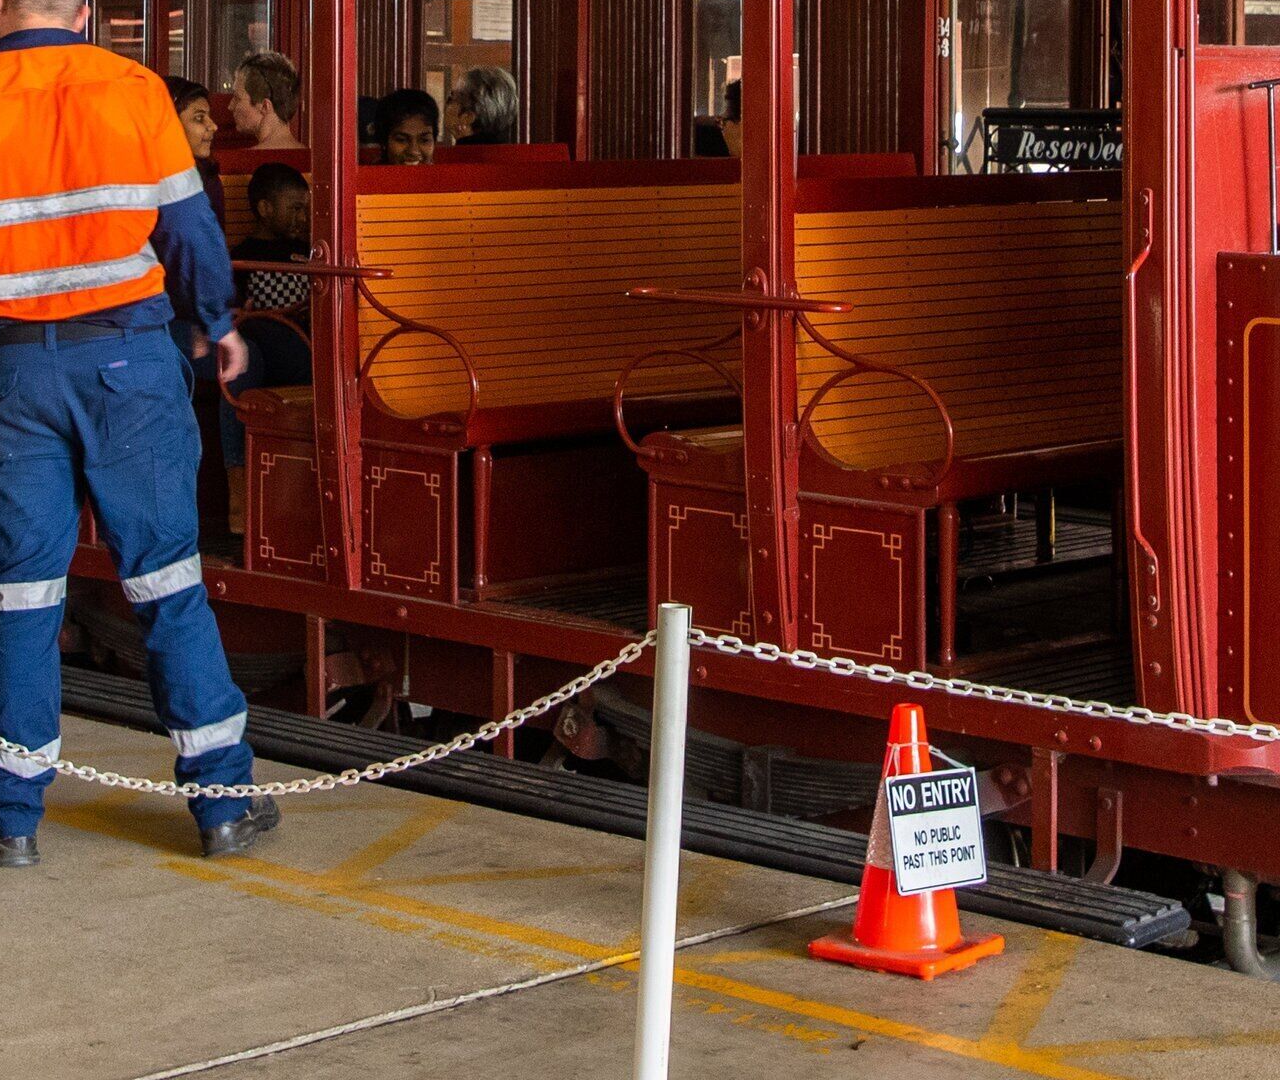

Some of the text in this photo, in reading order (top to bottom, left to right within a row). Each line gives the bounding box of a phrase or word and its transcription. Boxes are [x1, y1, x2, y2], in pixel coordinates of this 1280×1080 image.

[891, 777, 971, 811] NO ENTRY
[914, 825, 961, 846] NO PUBLIC
[903, 844, 976, 870] PAST THIS POINT
